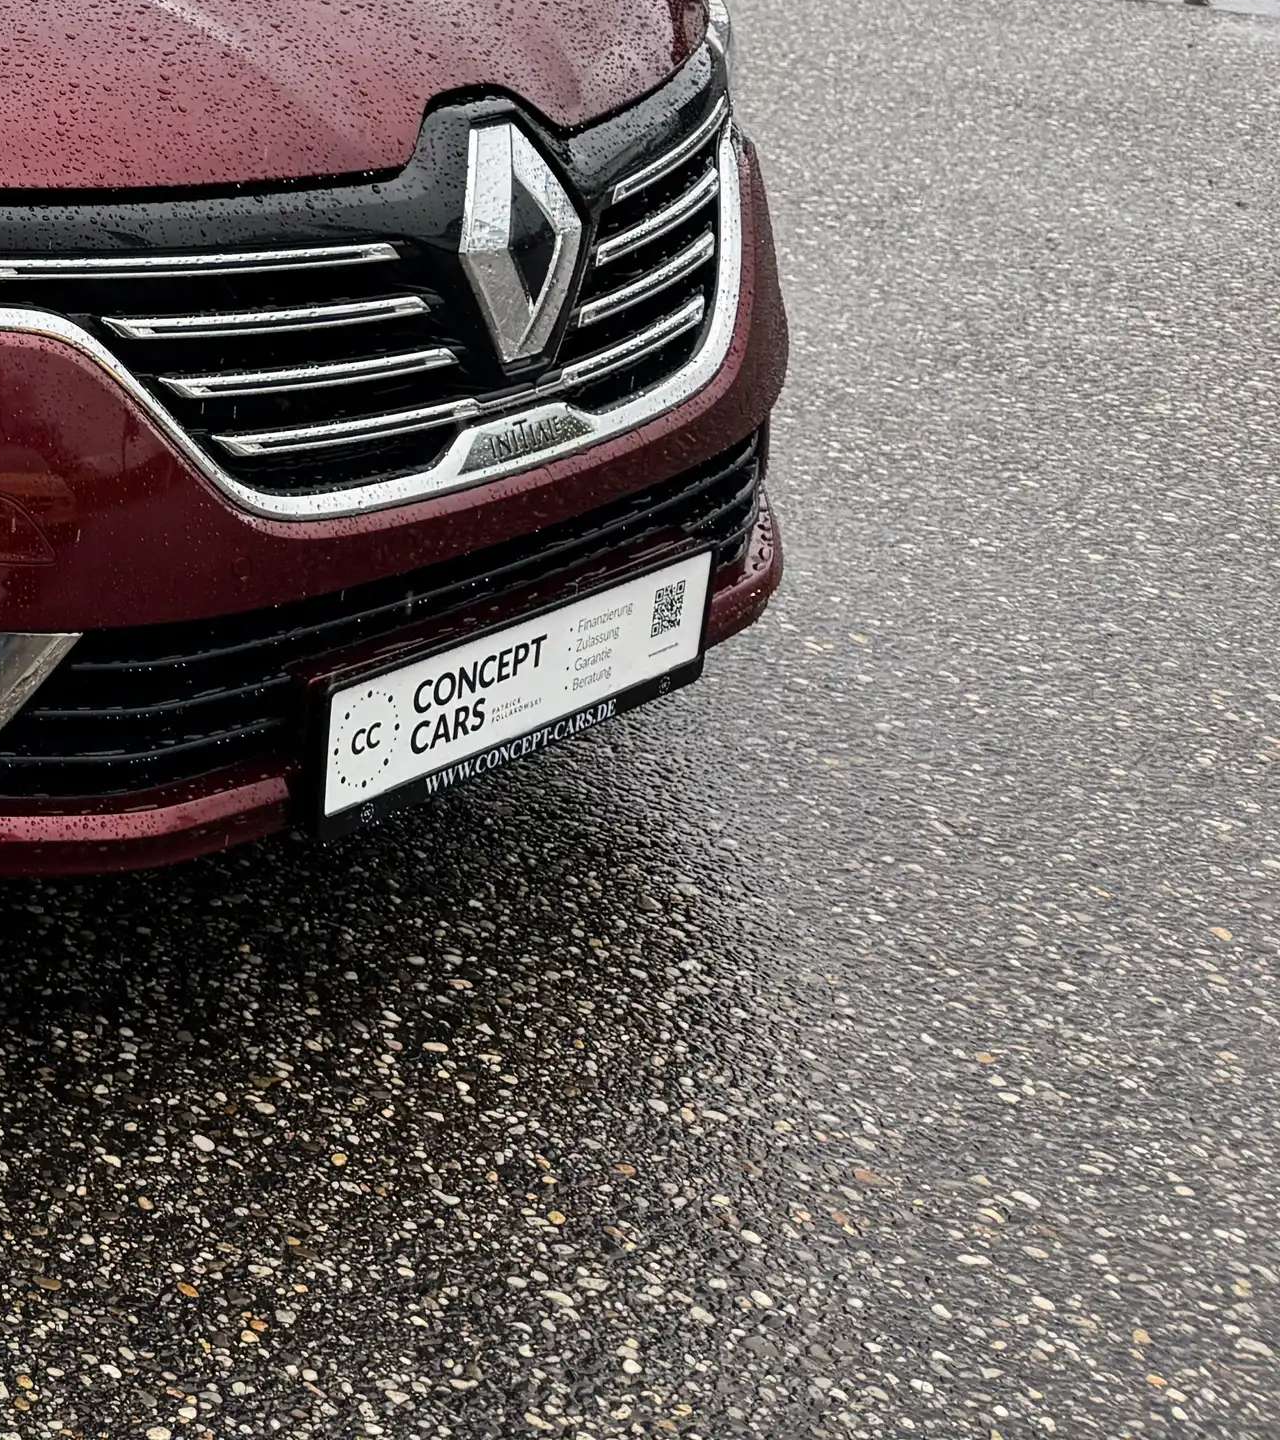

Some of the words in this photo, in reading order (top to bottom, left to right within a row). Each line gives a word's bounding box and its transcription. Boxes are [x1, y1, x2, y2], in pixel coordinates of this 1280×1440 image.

[577, 602, 634, 633] Finanzierung
[575, 626, 620, 653] Zulassung
[574, 646, 612, 672] Garantie
[413, 634, 548, 714] CONCEPT
[572, 666, 612, 691] Beratung
[491, 697, 543, 723] POLLAKOWSKI
[492, 697, 522, 715] PATRICK
[351, 722, 382, 755] CC
[410, 697, 486, 755] CARS
[425, 698, 617, 794] WWW.CONCEPT-CARS.DE
